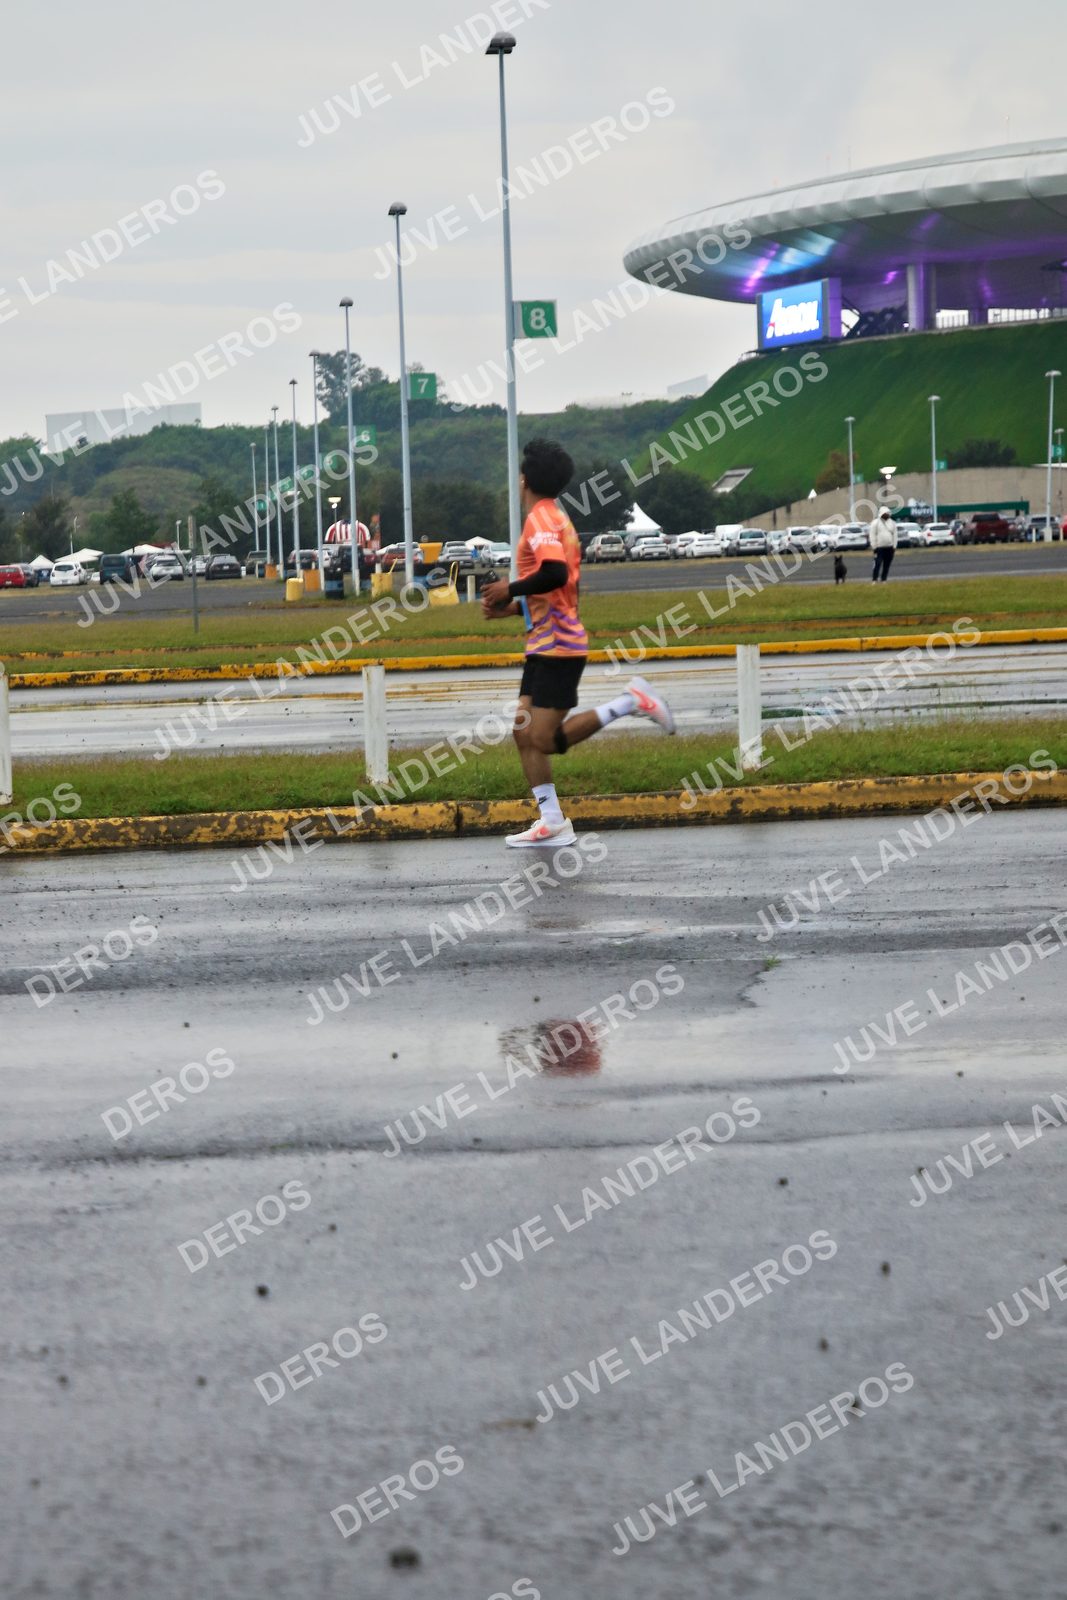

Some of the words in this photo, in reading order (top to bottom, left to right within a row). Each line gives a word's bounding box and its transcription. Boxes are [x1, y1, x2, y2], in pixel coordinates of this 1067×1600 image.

[530, 308, 546, 330] 8
[418, 378, 429, 394] 7
[361, 430, 370, 442] 6
